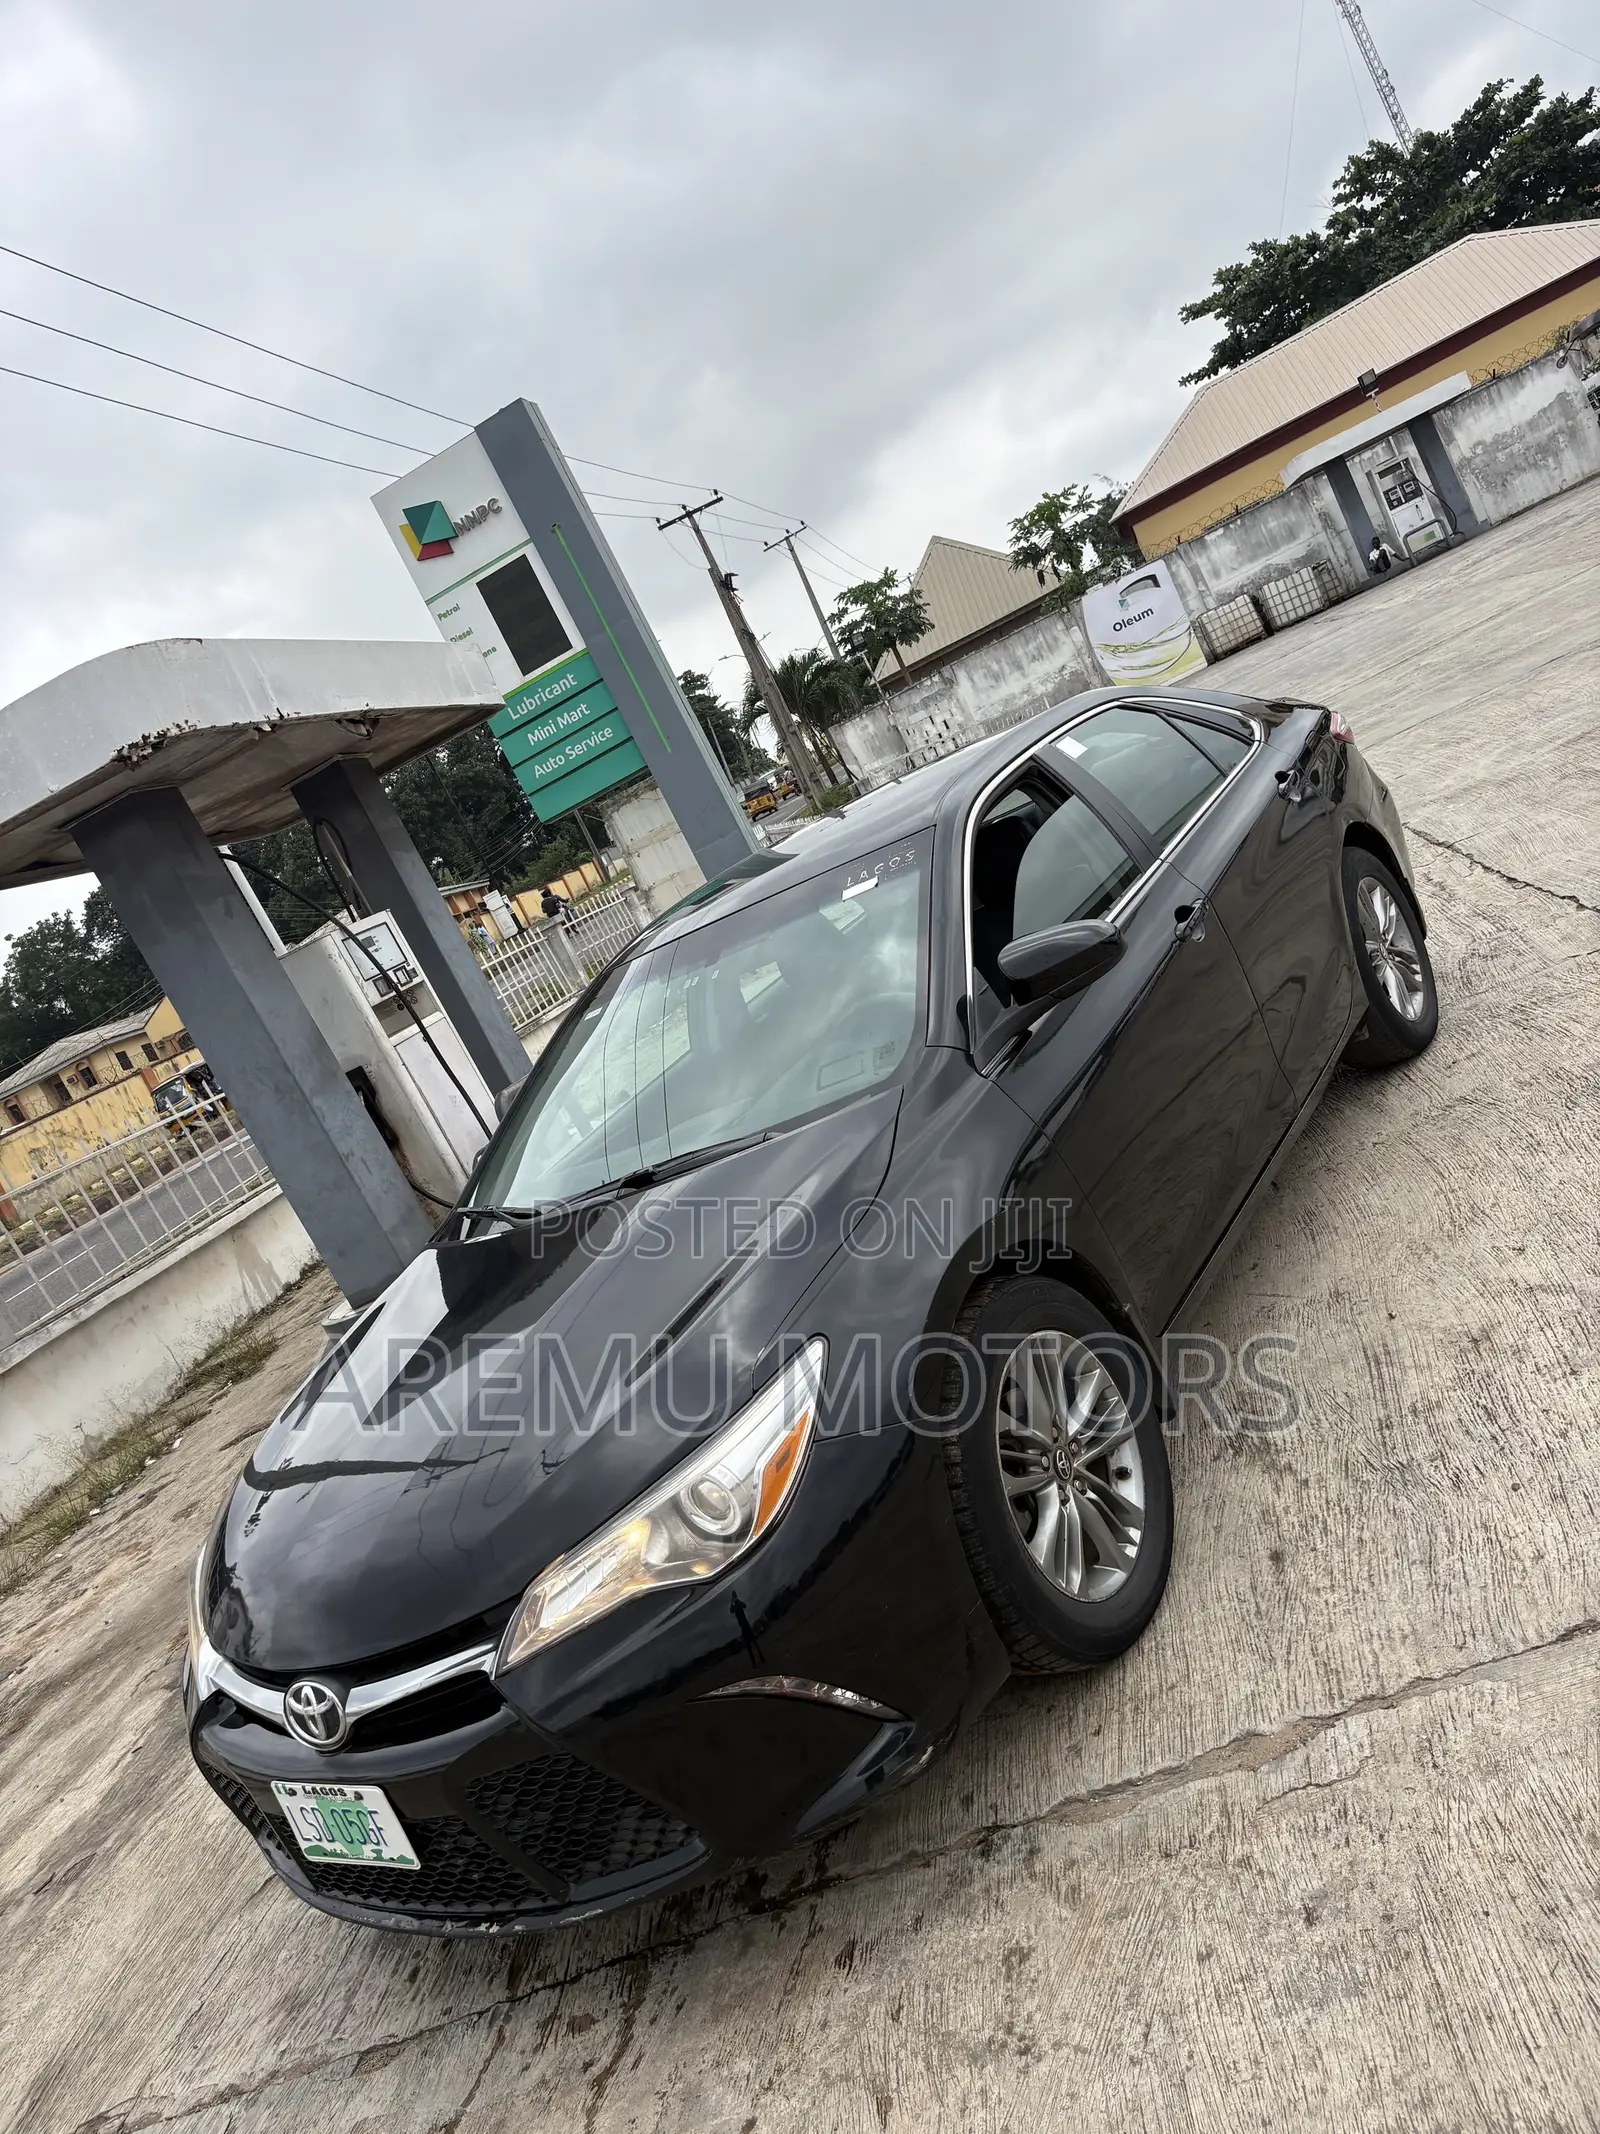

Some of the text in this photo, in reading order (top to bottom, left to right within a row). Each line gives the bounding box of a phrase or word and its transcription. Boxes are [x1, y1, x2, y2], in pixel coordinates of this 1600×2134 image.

[453, 498, 502, 536] NNPC
[437, 603, 461, 621] Petrol
[1113, 607, 1154, 632] Oleum
[450, 626, 474, 643] Diesel
[507, 673, 577, 720] Lubricant
[527, 703, 590, 745] Mini Mart
[534, 727, 613, 779] Auto Service
[846, 850, 916, 887] LAGOS
[302, 1785, 348, 1797] LAGOS
